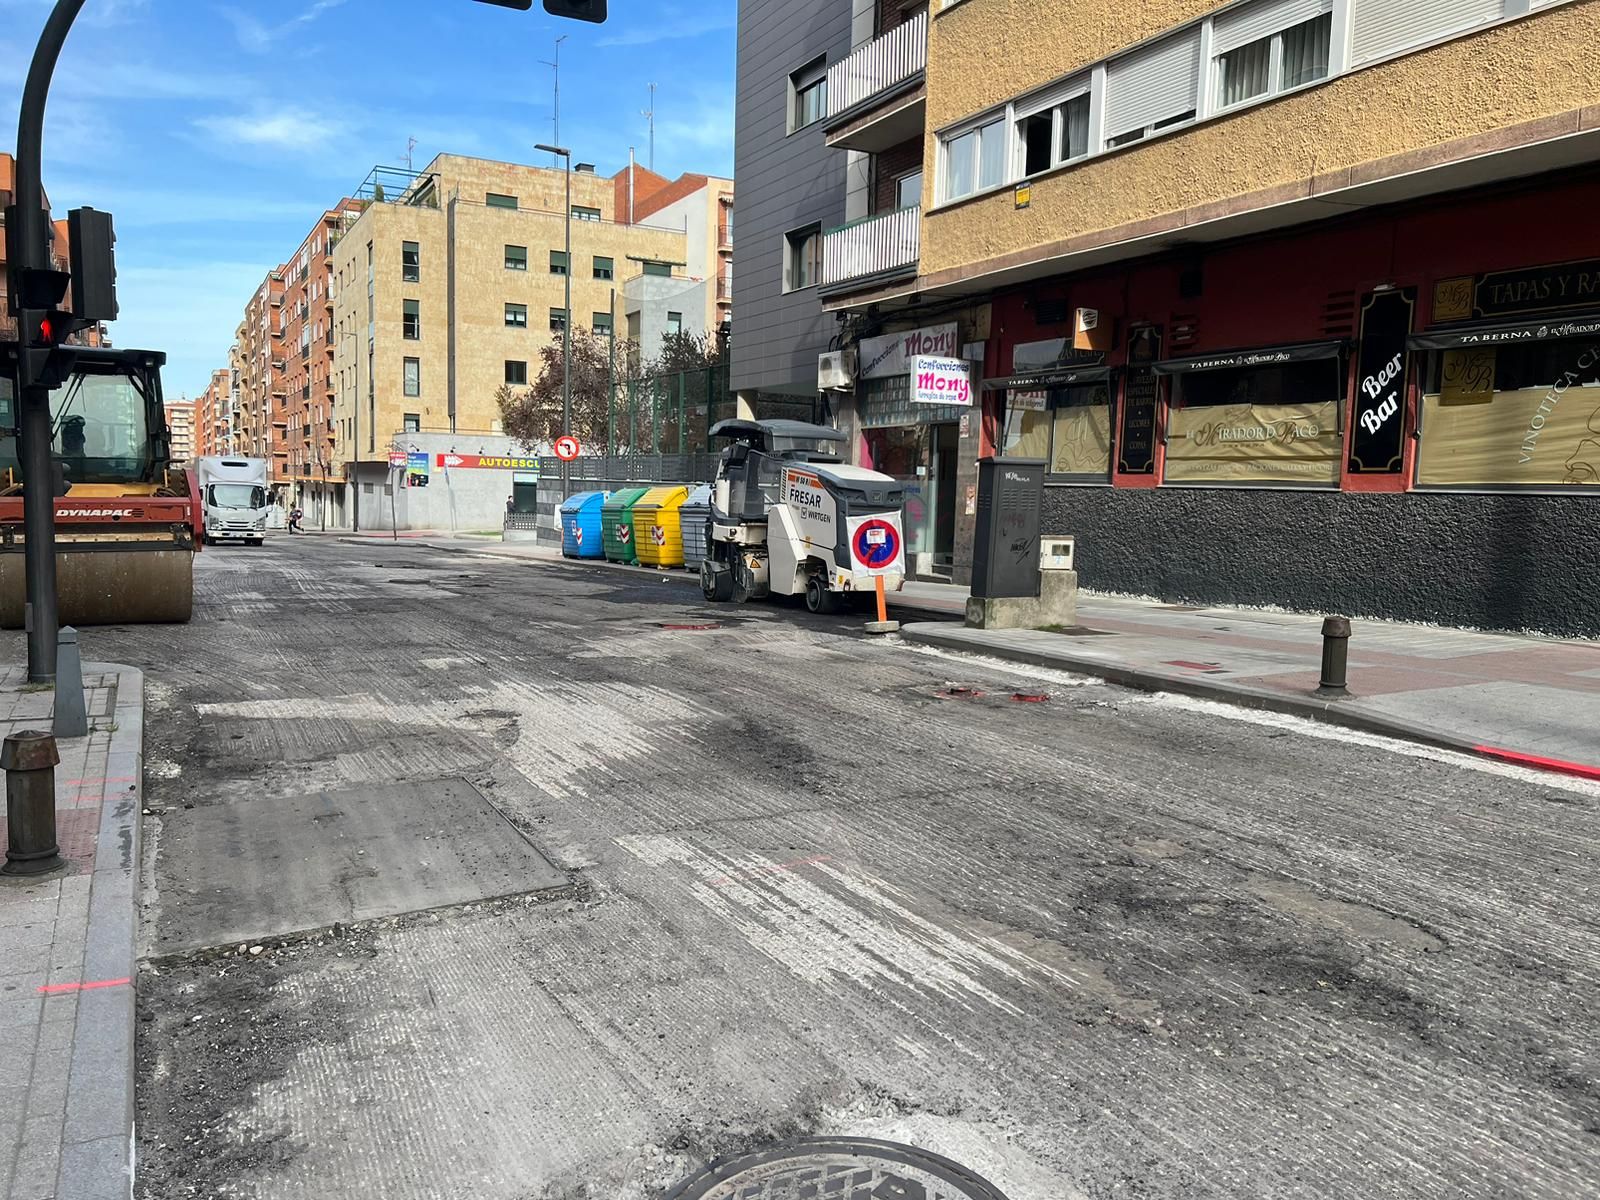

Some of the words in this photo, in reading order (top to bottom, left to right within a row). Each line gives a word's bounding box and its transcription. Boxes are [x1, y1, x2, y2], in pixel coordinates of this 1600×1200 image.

[1490, 278, 1551, 305] TAPAS
[1557, 275, 1571, 297] Y
[904, 331, 957, 358] Mony
[918, 359, 970, 373] Confecciones
[1190, 358, 1235, 370] TABERNA
[1361, 352, 1402, 399] Beer
[917, 372, 970, 402] Mony
[1360, 391, 1399, 435] Bar
[1518, 371, 1580, 464] VINOTECA
[1194, 422, 1267, 447] MIRADOR
[790, 488, 822, 508] FRESAR
[56, 509, 134, 517] DYNAPAC
[808, 511, 831, 524] WIRTGEN
